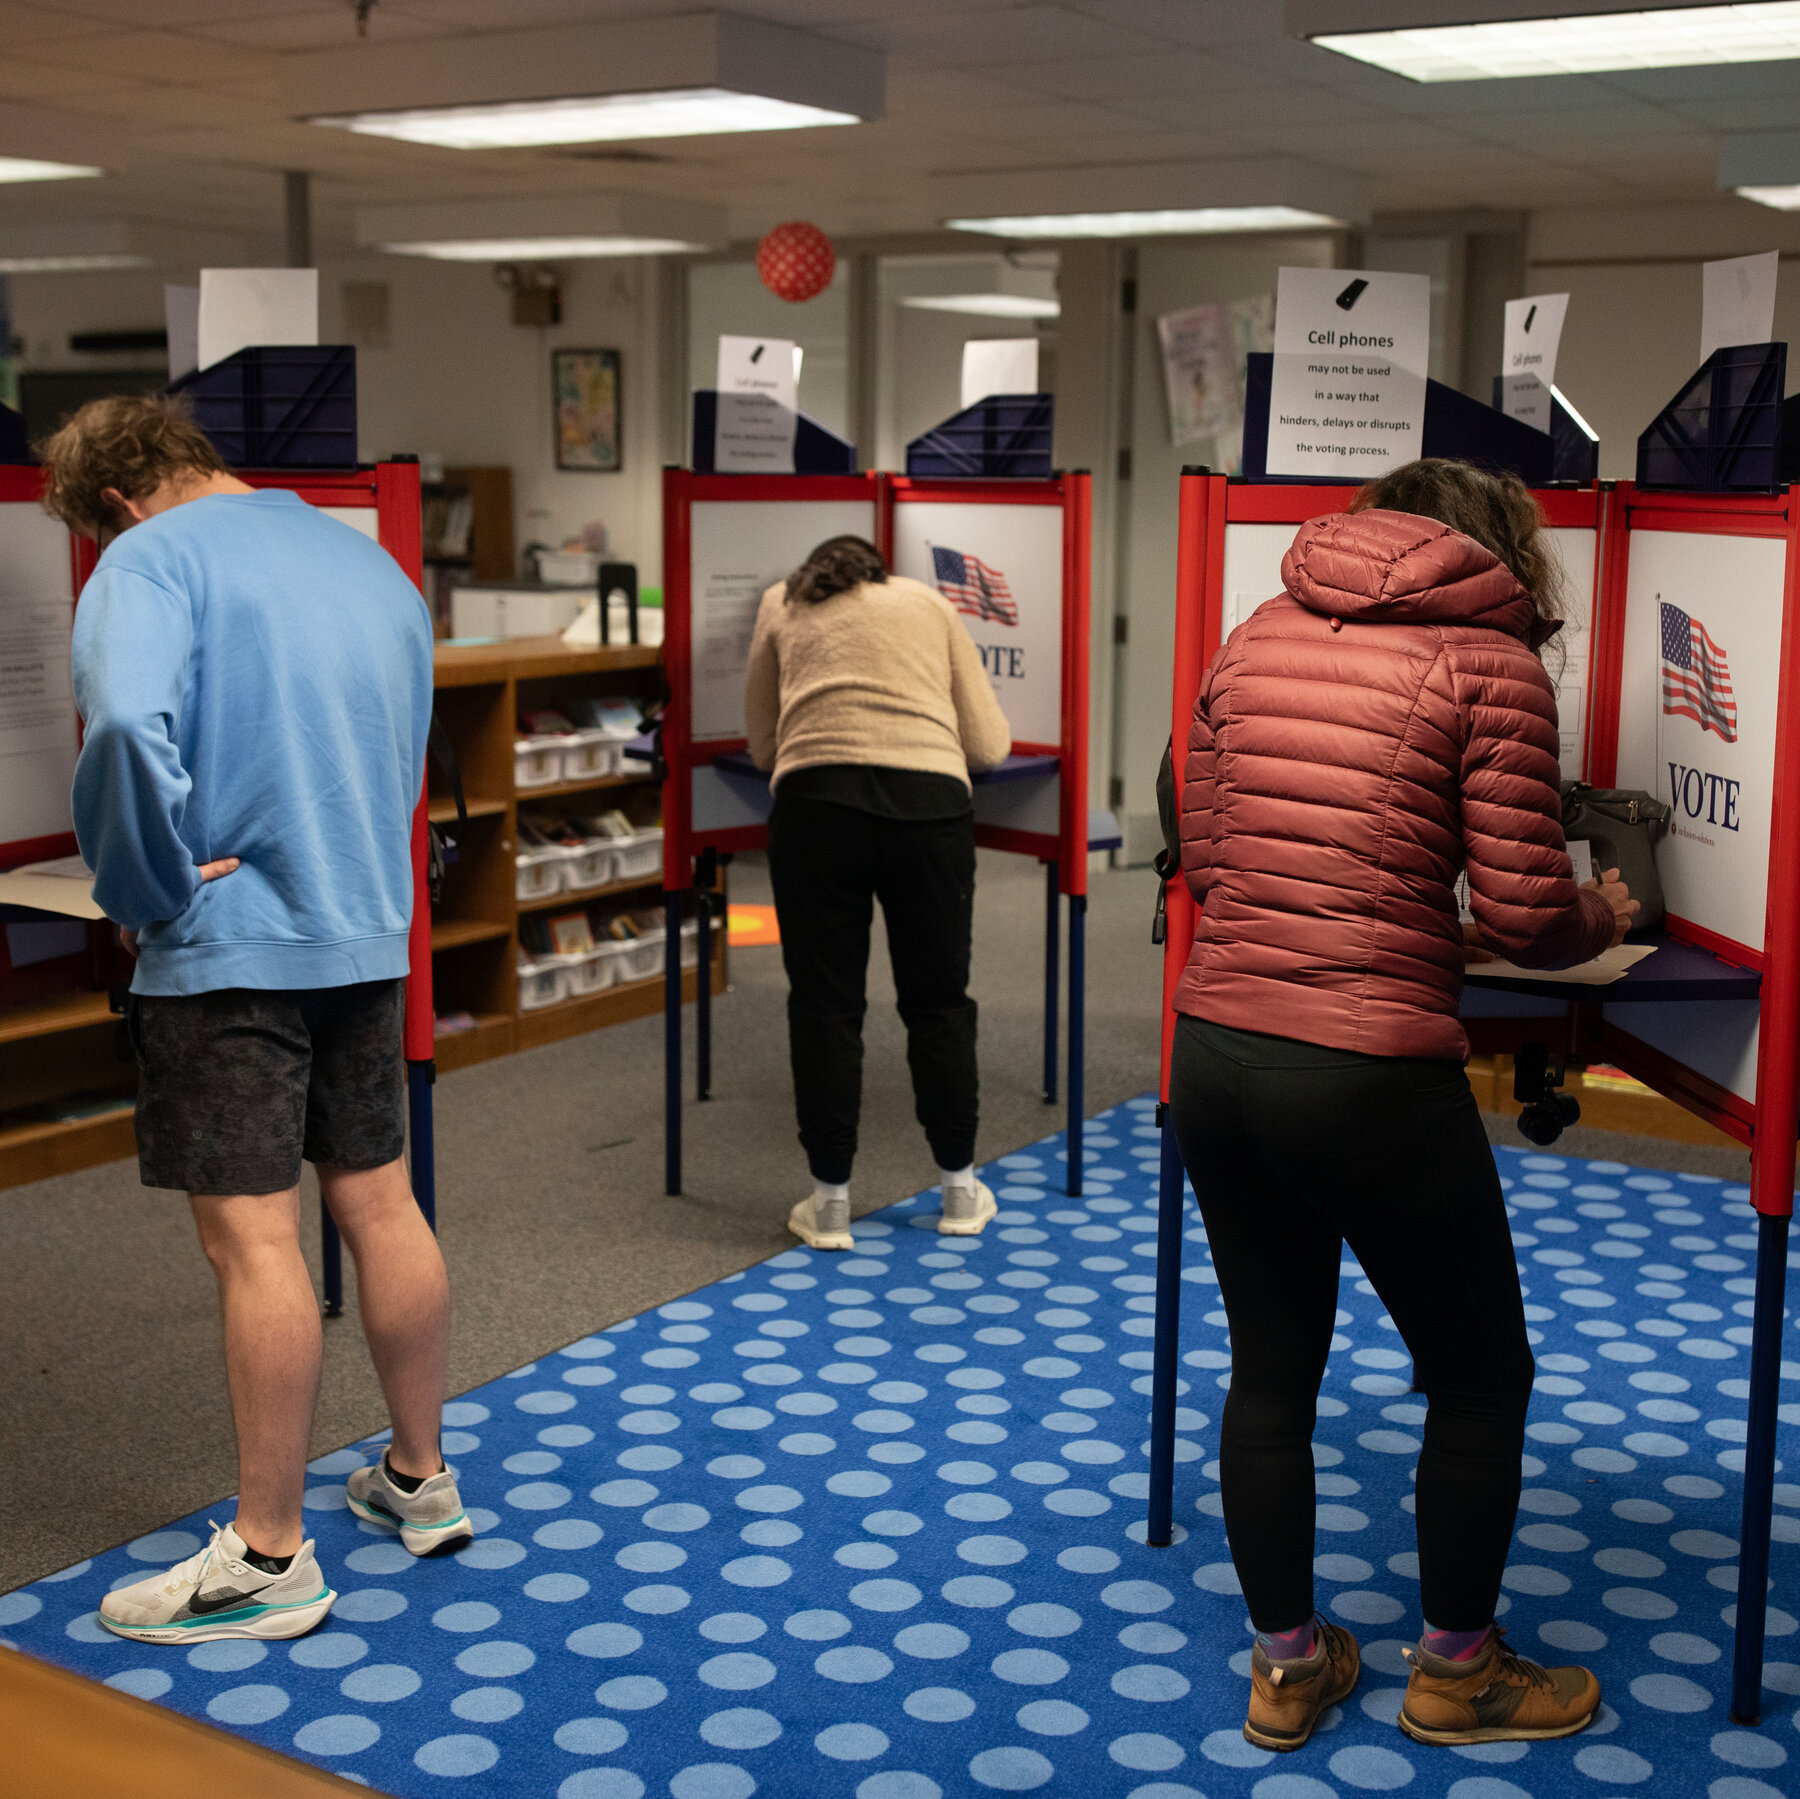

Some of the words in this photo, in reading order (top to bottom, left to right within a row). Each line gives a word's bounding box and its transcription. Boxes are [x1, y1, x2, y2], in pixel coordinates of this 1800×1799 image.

[1308, 330, 1335, 345] Cell
[1339, 331, 1394, 348] phones
[1307, 364, 1329, 375] may
[1331, 364, 1349, 374] not
[1351, 364, 1364, 375] be
[1367, 366, 1391, 376] used
[1314, 390, 1325, 400] in
[1335, 393, 1356, 403] way
[1359, 391, 1380, 402] that
[1279, 415, 1320, 428] hinders,
[1322, 417, 1354, 429] delays
[1356, 420, 1367, 429] or
[1370, 419, 1411, 432] disrupts
[1296, 443, 1313, 453] the
[1315, 444, 1347, 456] voting
[1349, 447, 1390, 457] process.
[1668, 762, 1740, 832] VOTE
